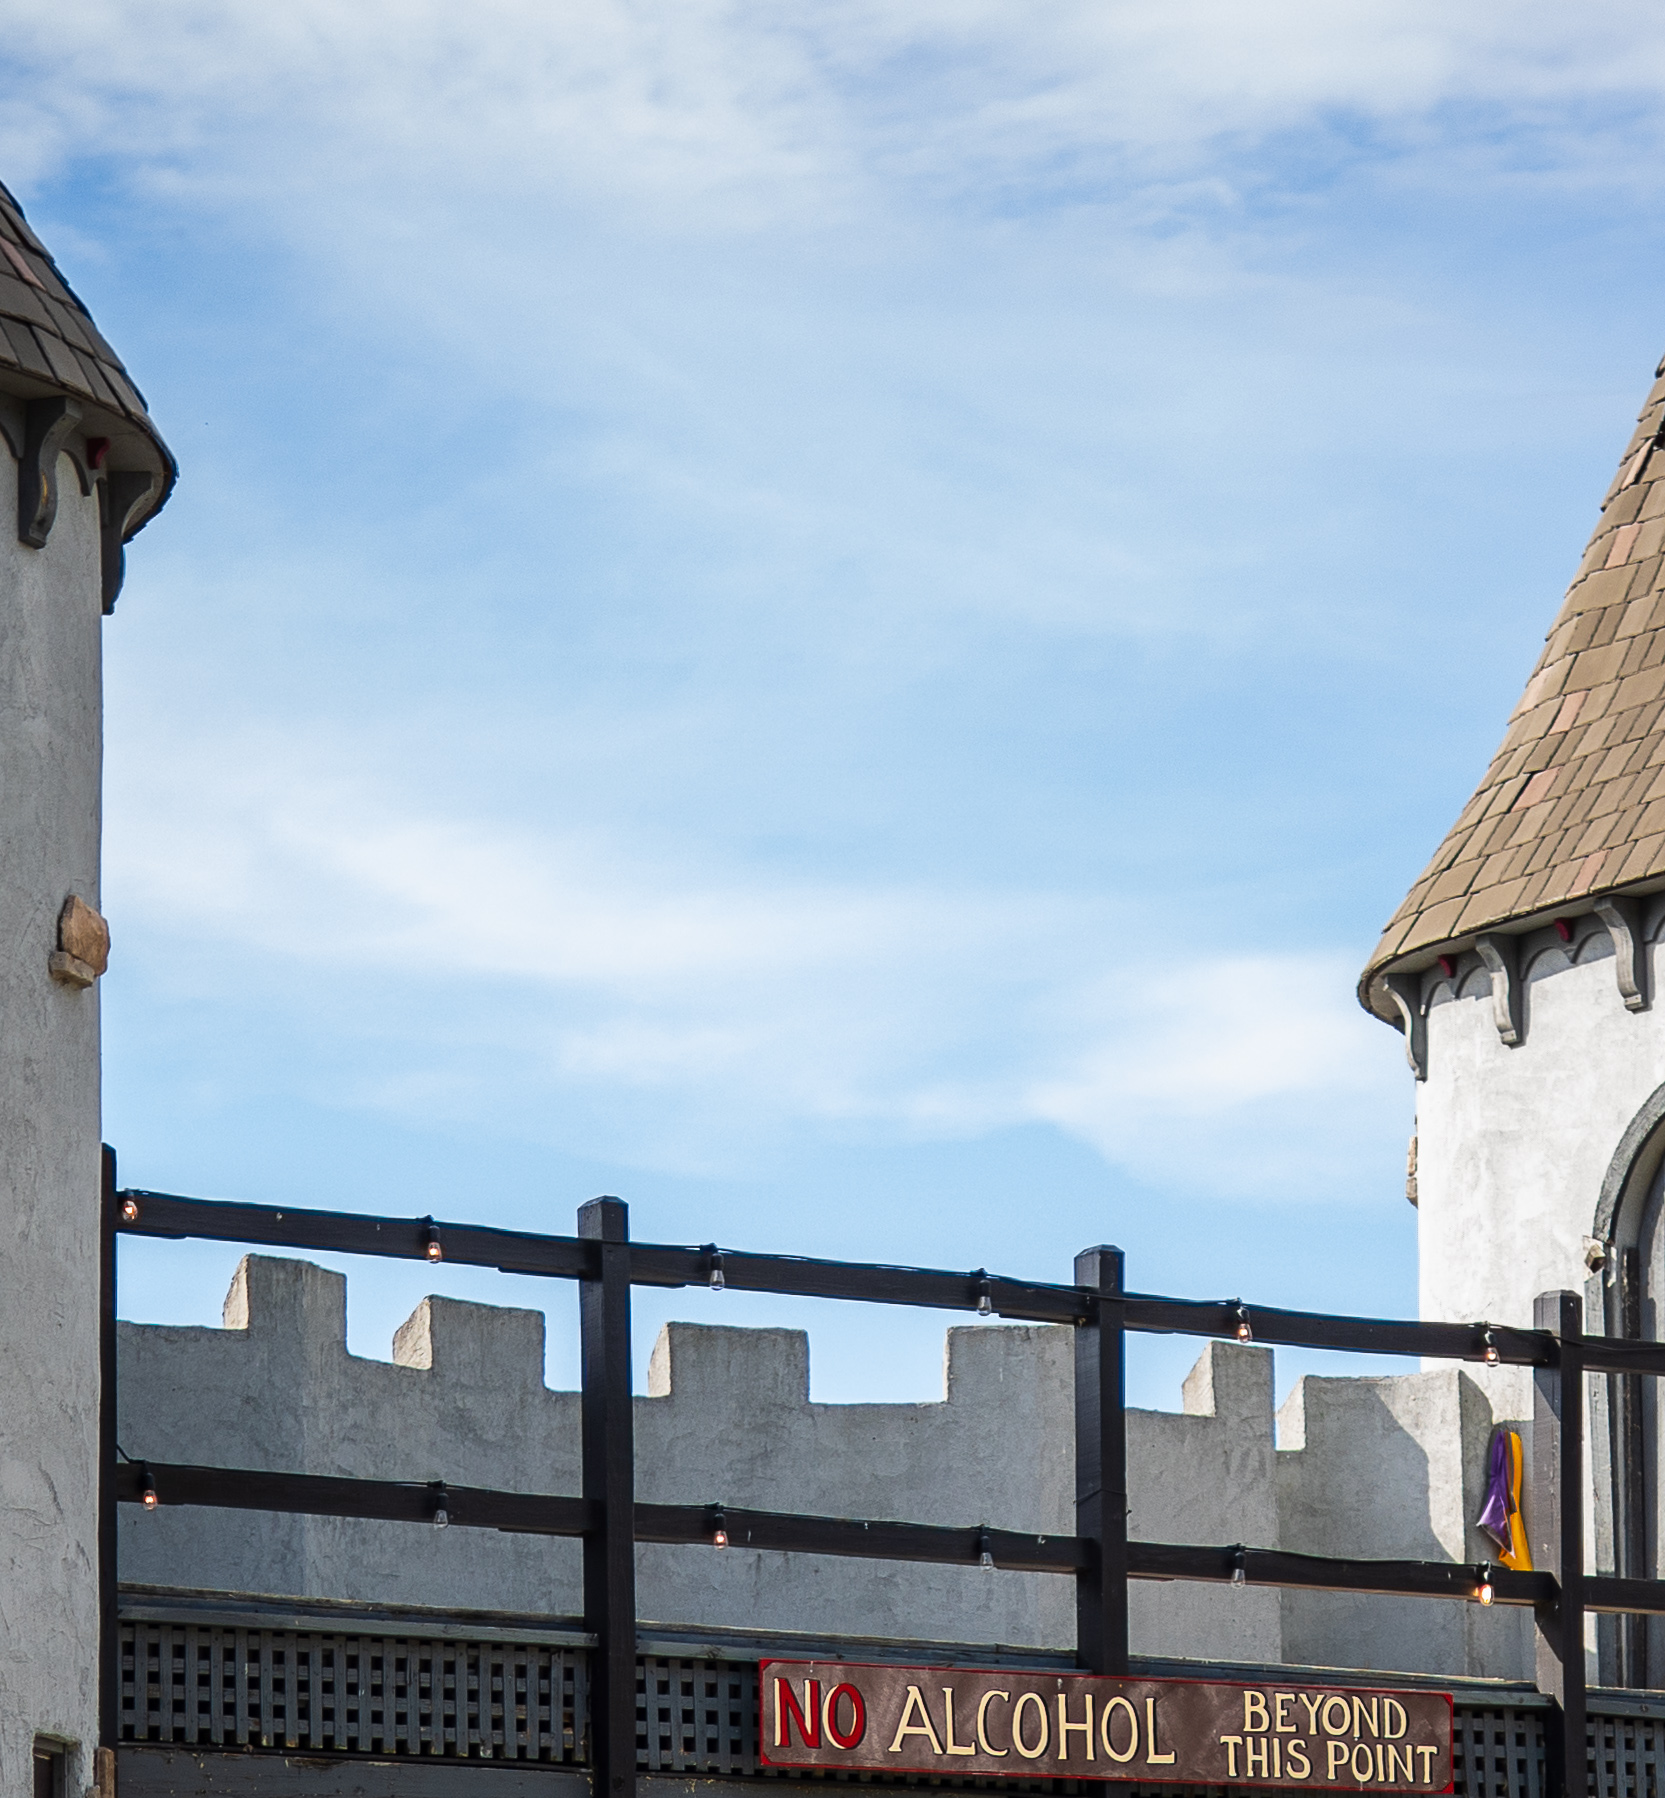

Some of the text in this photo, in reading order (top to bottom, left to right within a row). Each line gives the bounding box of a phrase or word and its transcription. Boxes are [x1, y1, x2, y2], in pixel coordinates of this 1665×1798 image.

[773, 1677, 1176, 1765] NO ALCOHOL
[1242, 1690, 1408, 1740] BEYOND
[1219, 1735, 1439, 1784] THIS POINT
